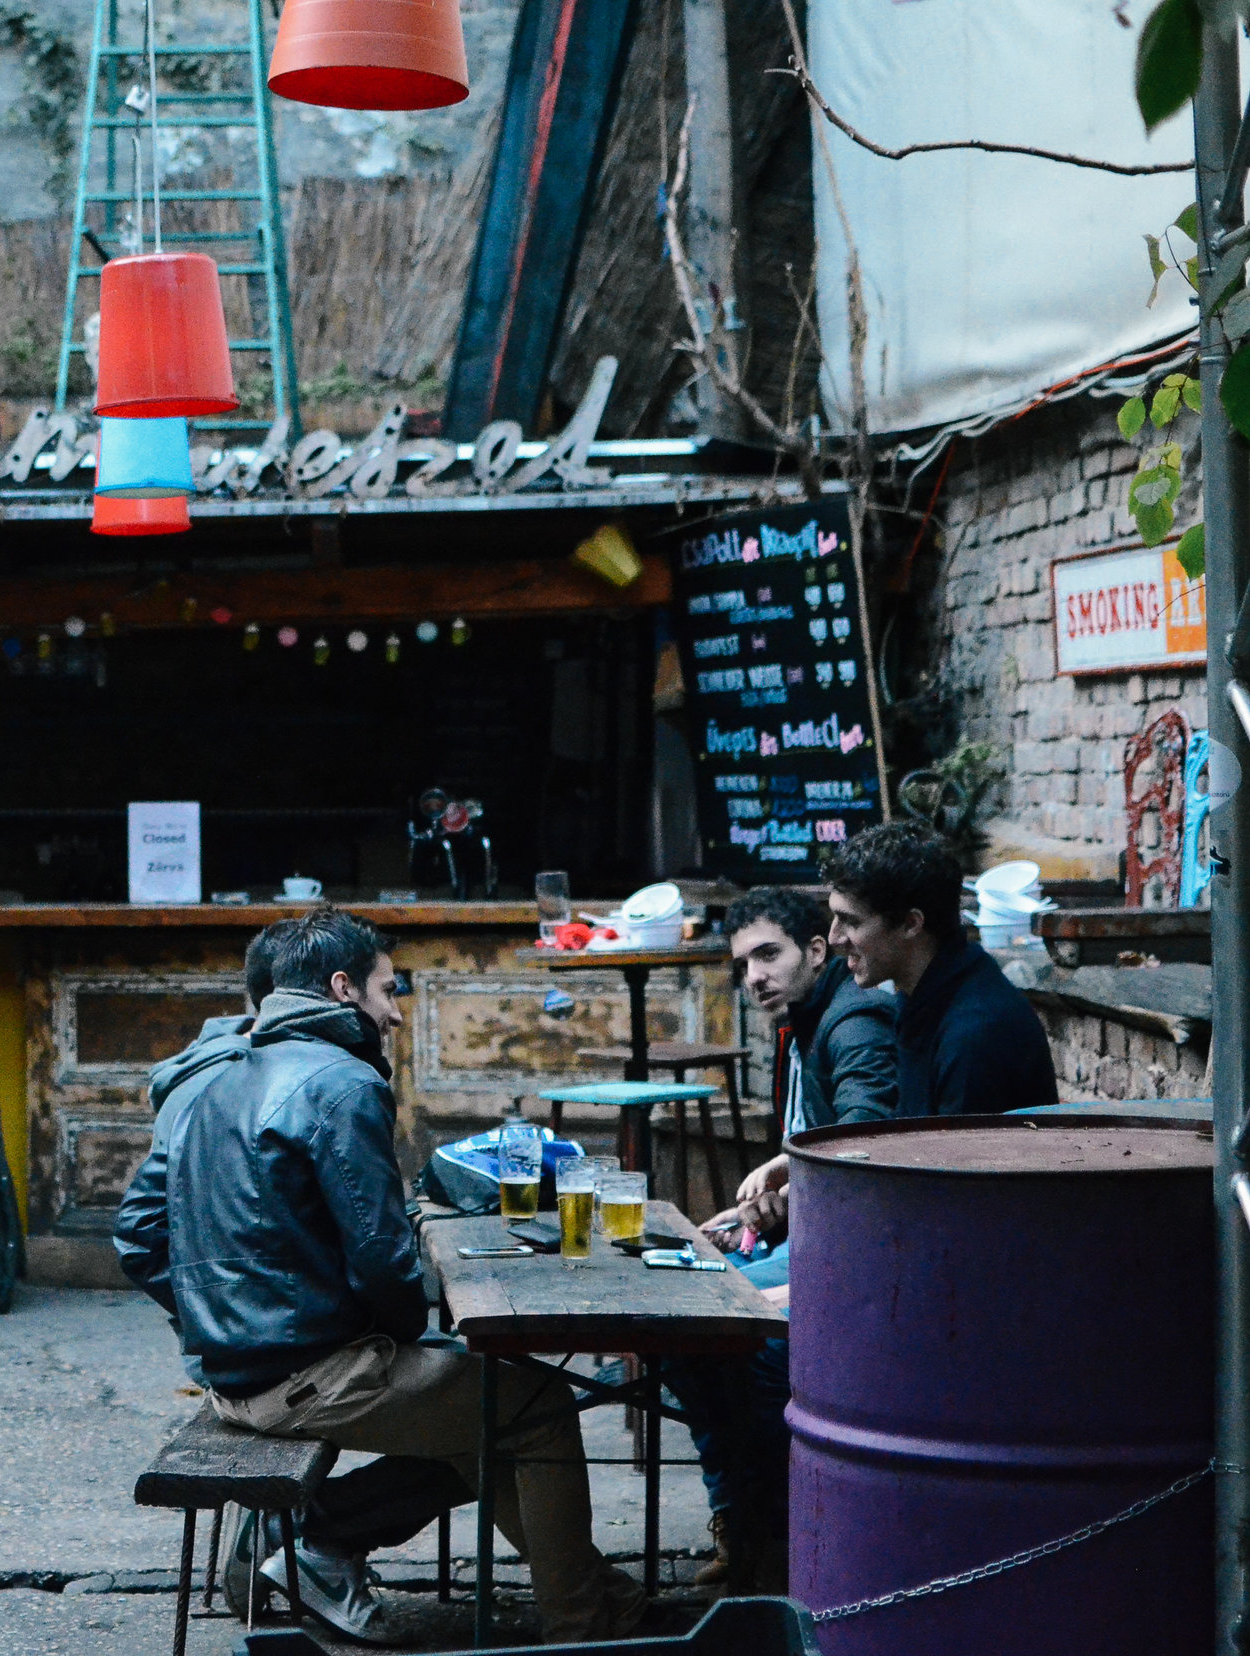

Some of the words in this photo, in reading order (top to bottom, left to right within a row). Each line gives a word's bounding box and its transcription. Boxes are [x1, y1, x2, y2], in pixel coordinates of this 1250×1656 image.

[1067, 581, 1159, 640] SMOKING
[1170, 573, 1206, 627] AR
[142, 833, 186, 844] Closed
